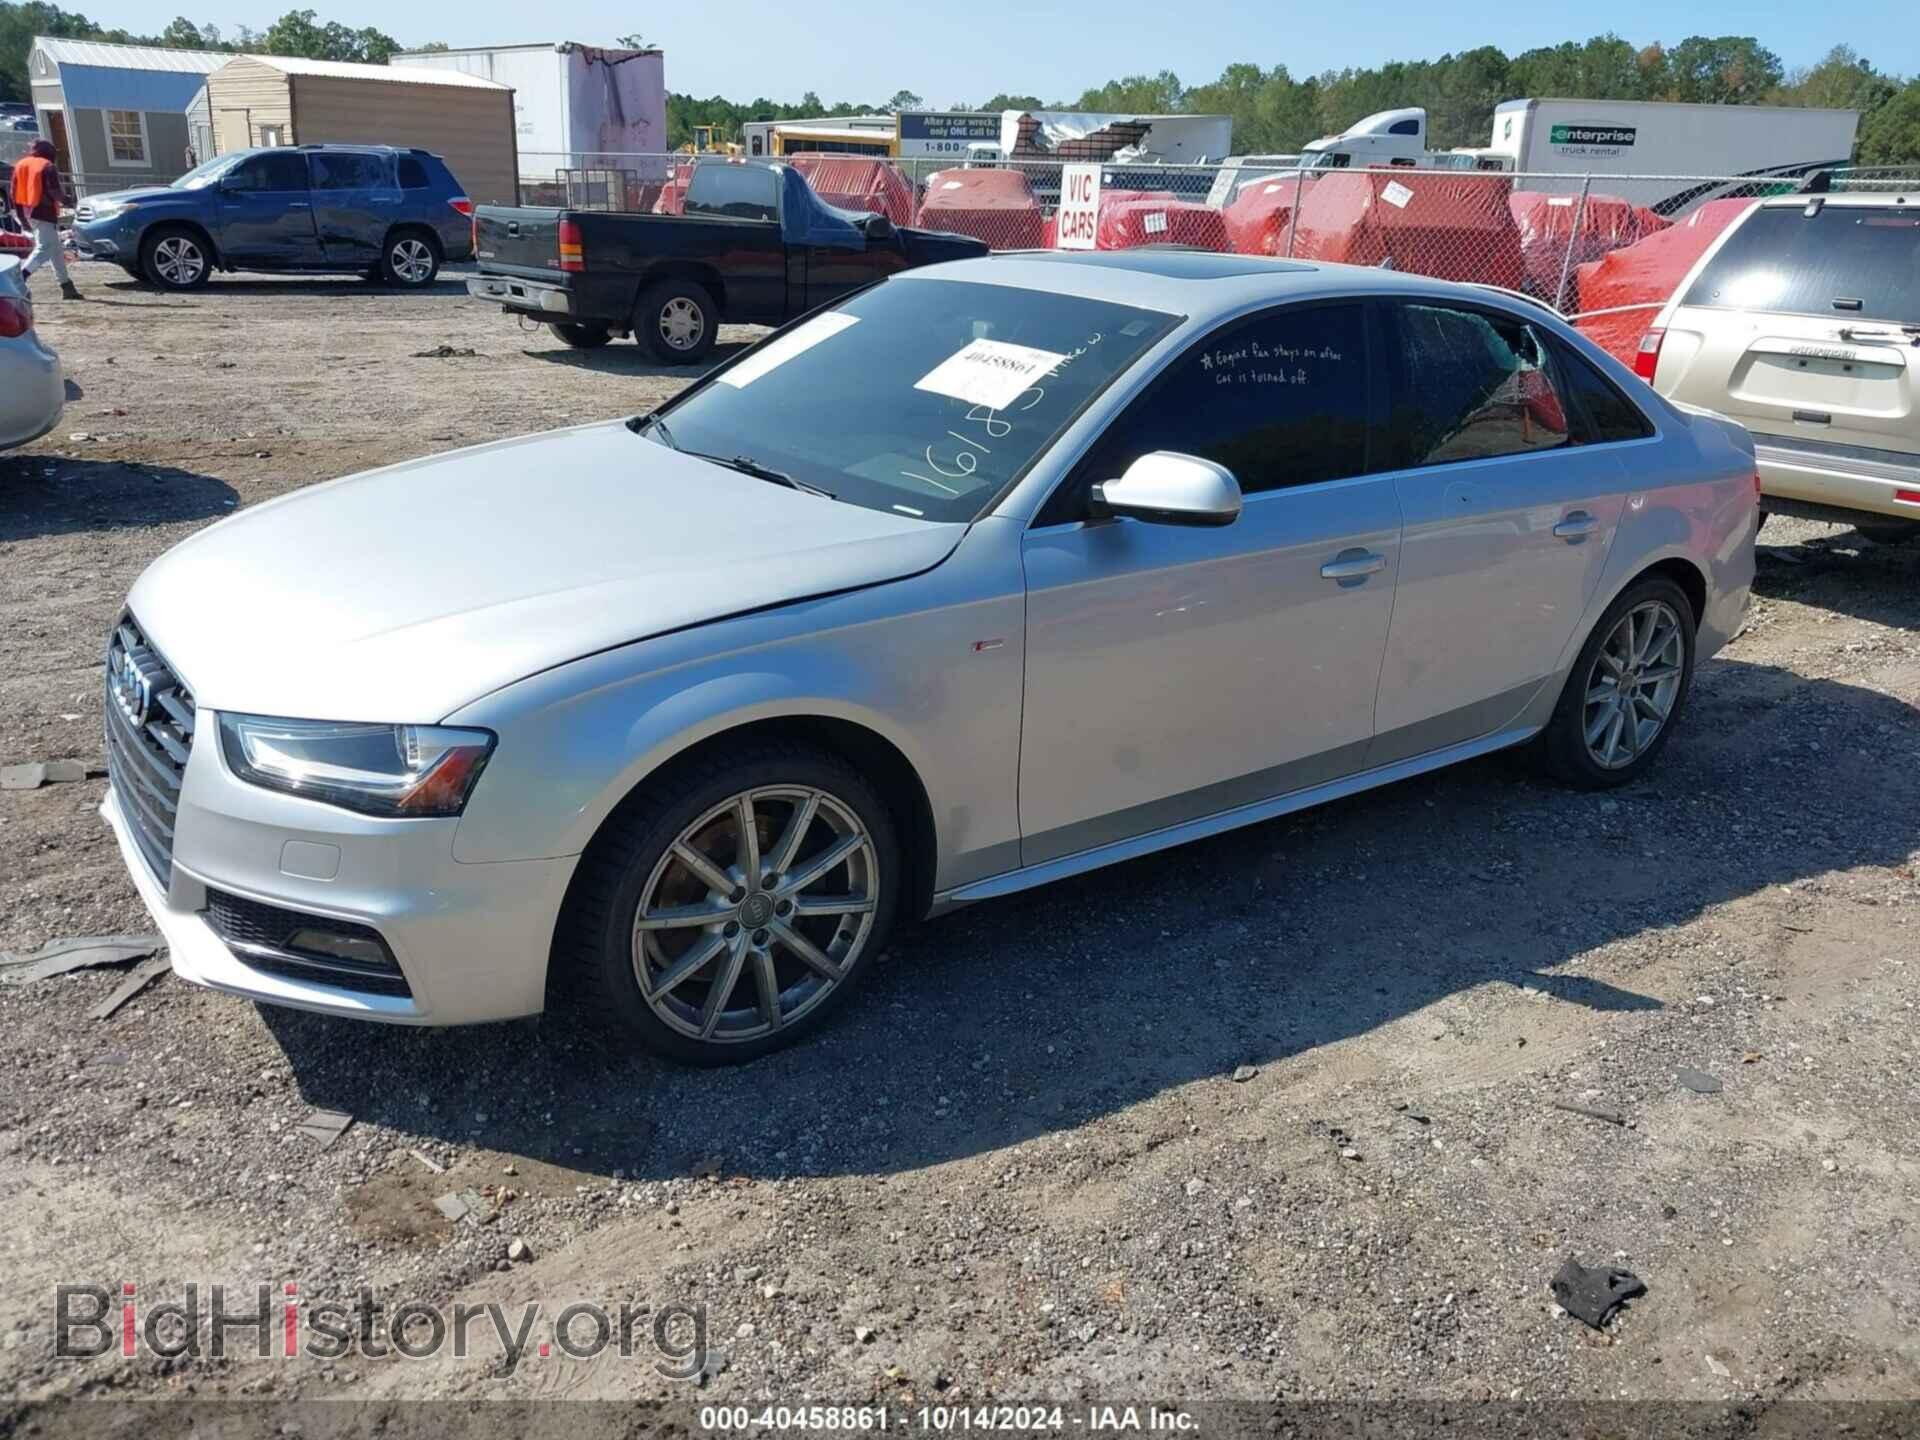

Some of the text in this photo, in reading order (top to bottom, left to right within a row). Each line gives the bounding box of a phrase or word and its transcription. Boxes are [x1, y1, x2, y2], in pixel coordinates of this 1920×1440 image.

[924, 117, 944, 127] After
[953, 118, 966, 127] car
[930, 128, 948, 137] only
[950, 126, 968, 136] ONE
[969, 127, 985, 136] call
[986, 127, 996, 136] to
[1555, 129, 1635, 143] enterprise
[1561, 146, 1620, 156] truck rental
[1070, 174, 1092, 202] VIC
[1061, 211, 1095, 240] CARS
[1273, 343, 1300, 362] stays
[1304, 347, 1317, 359] on
[1320, 345, 1342, 361] after
[1239, 372, 1248, 383] is
[1251, 368, 1287, 384] turned
